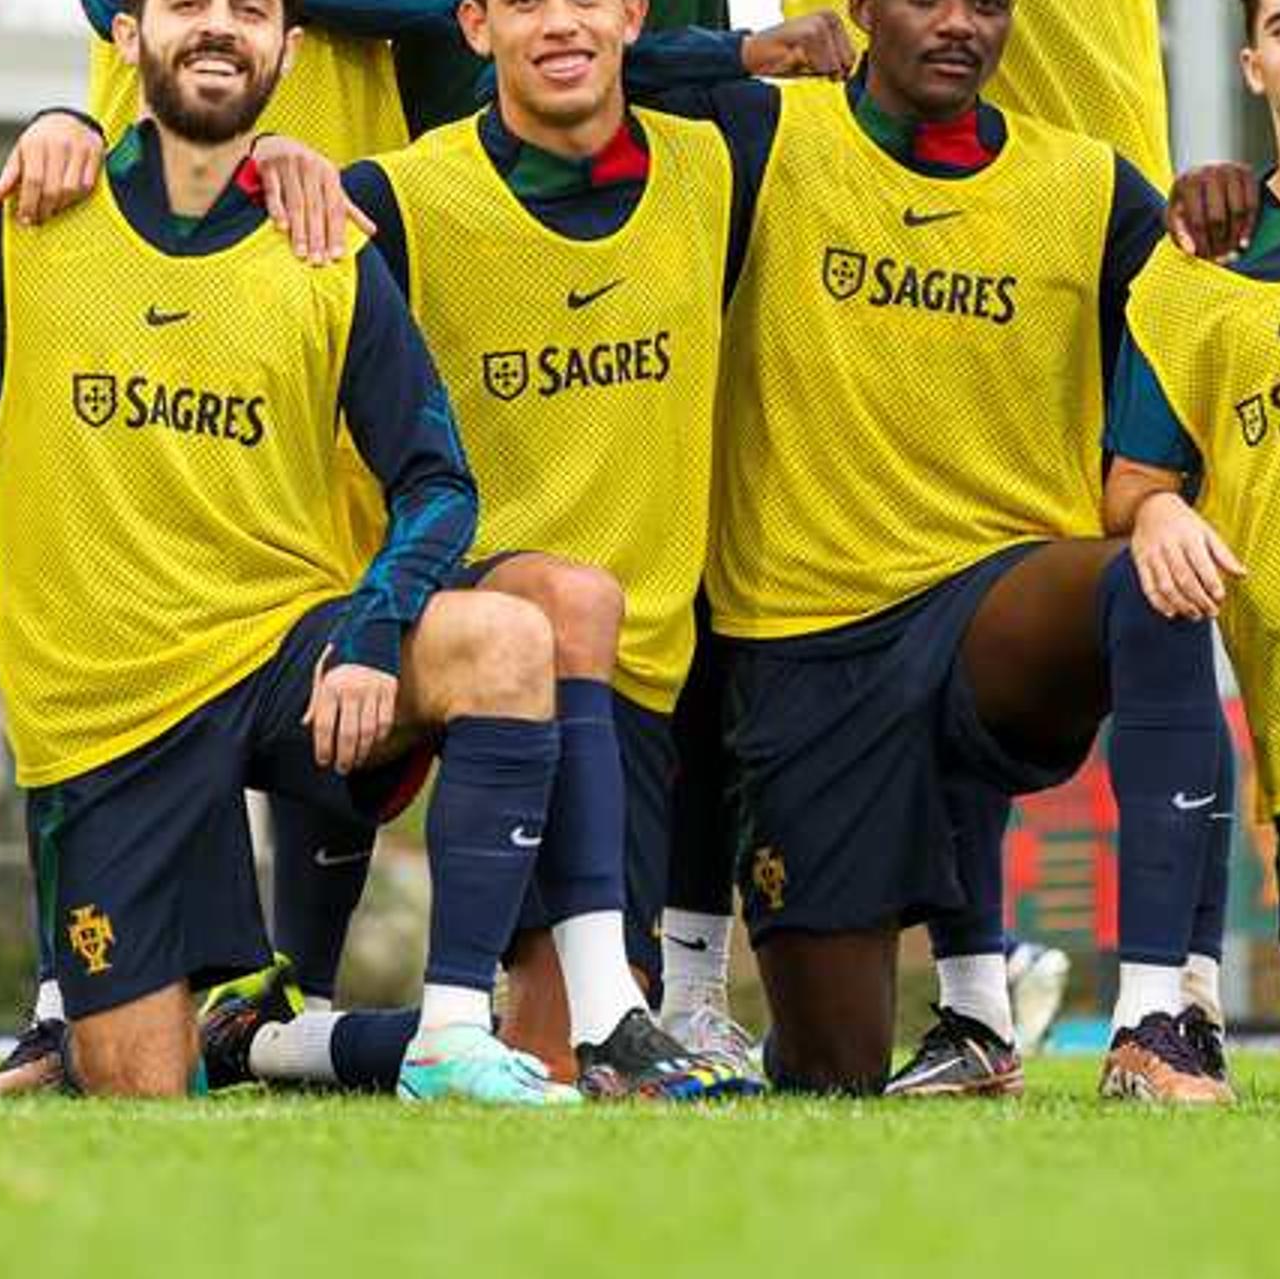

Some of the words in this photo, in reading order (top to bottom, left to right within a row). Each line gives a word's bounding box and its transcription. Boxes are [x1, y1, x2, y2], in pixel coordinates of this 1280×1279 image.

[868, 256, 1018, 325] SAGRES
[537, 330, 671, 399] SAGRES
[124, 375, 266, 448] SAGRES
